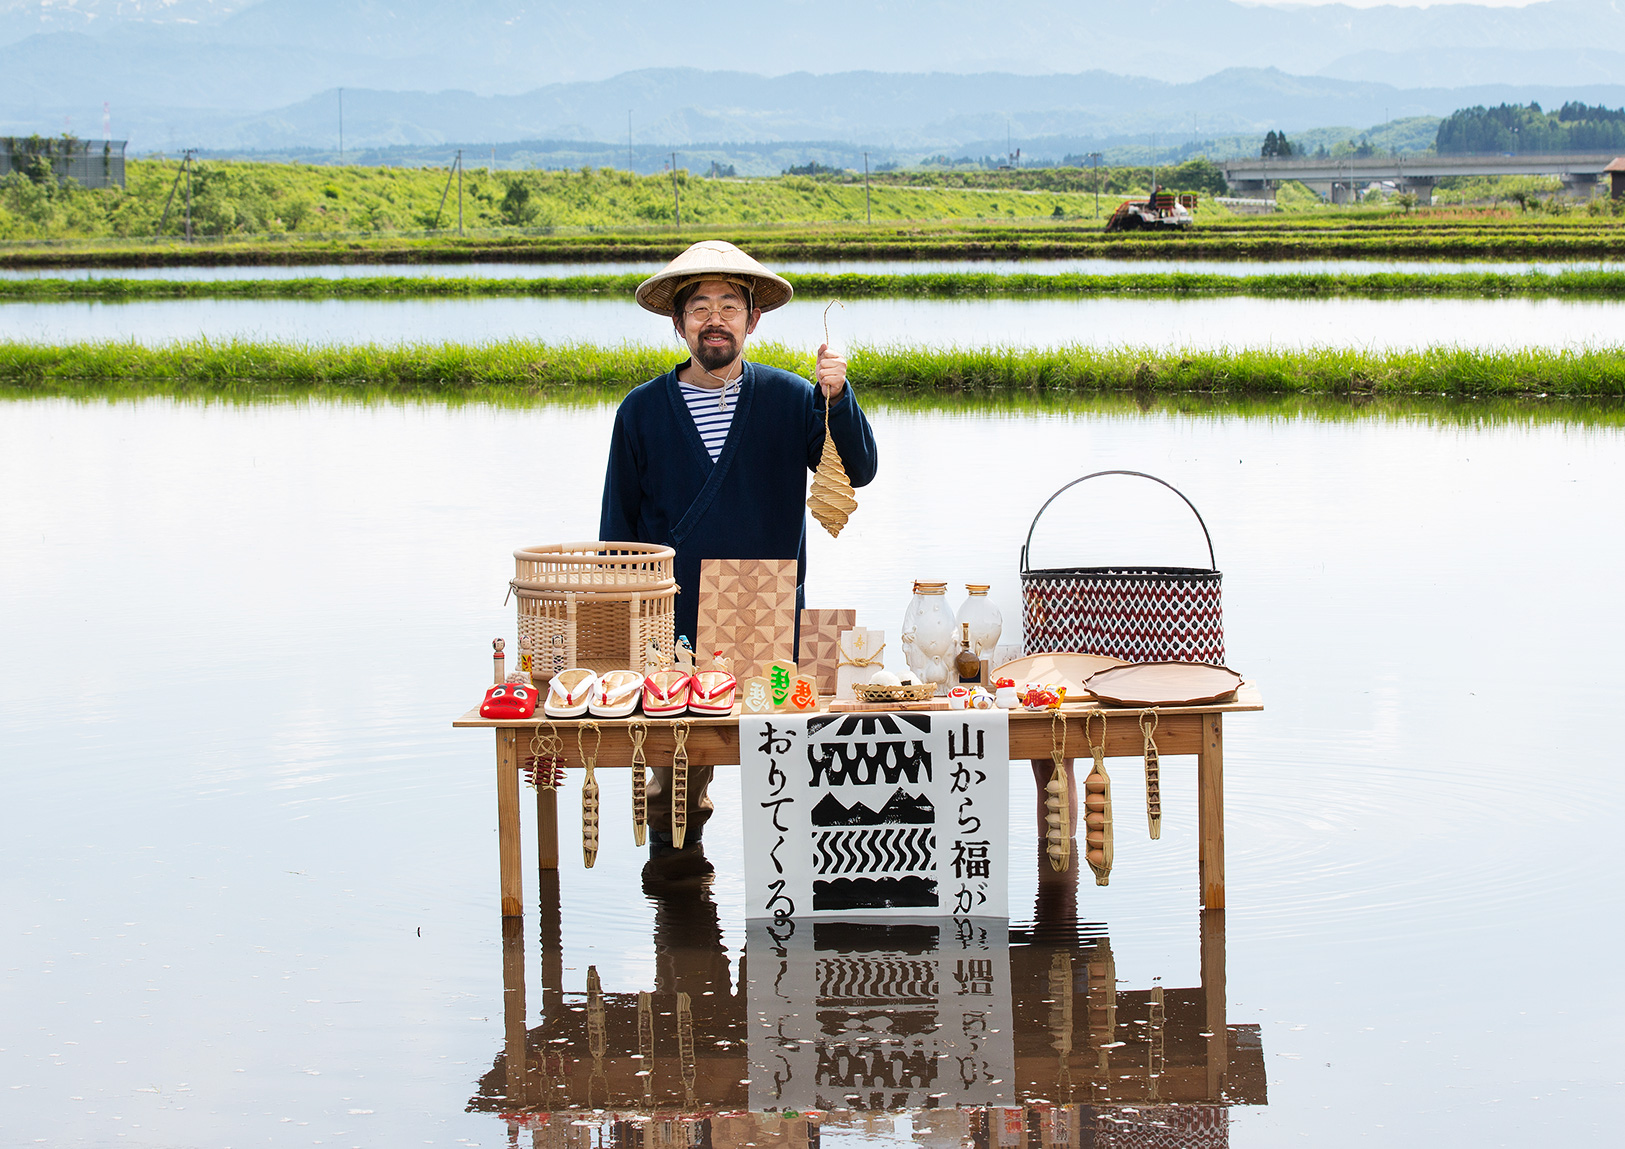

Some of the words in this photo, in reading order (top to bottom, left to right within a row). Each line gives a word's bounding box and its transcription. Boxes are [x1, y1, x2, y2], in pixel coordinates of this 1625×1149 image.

[758, 721, 797, 918] おりてくる
[948, 723, 991, 914] 山から福が
